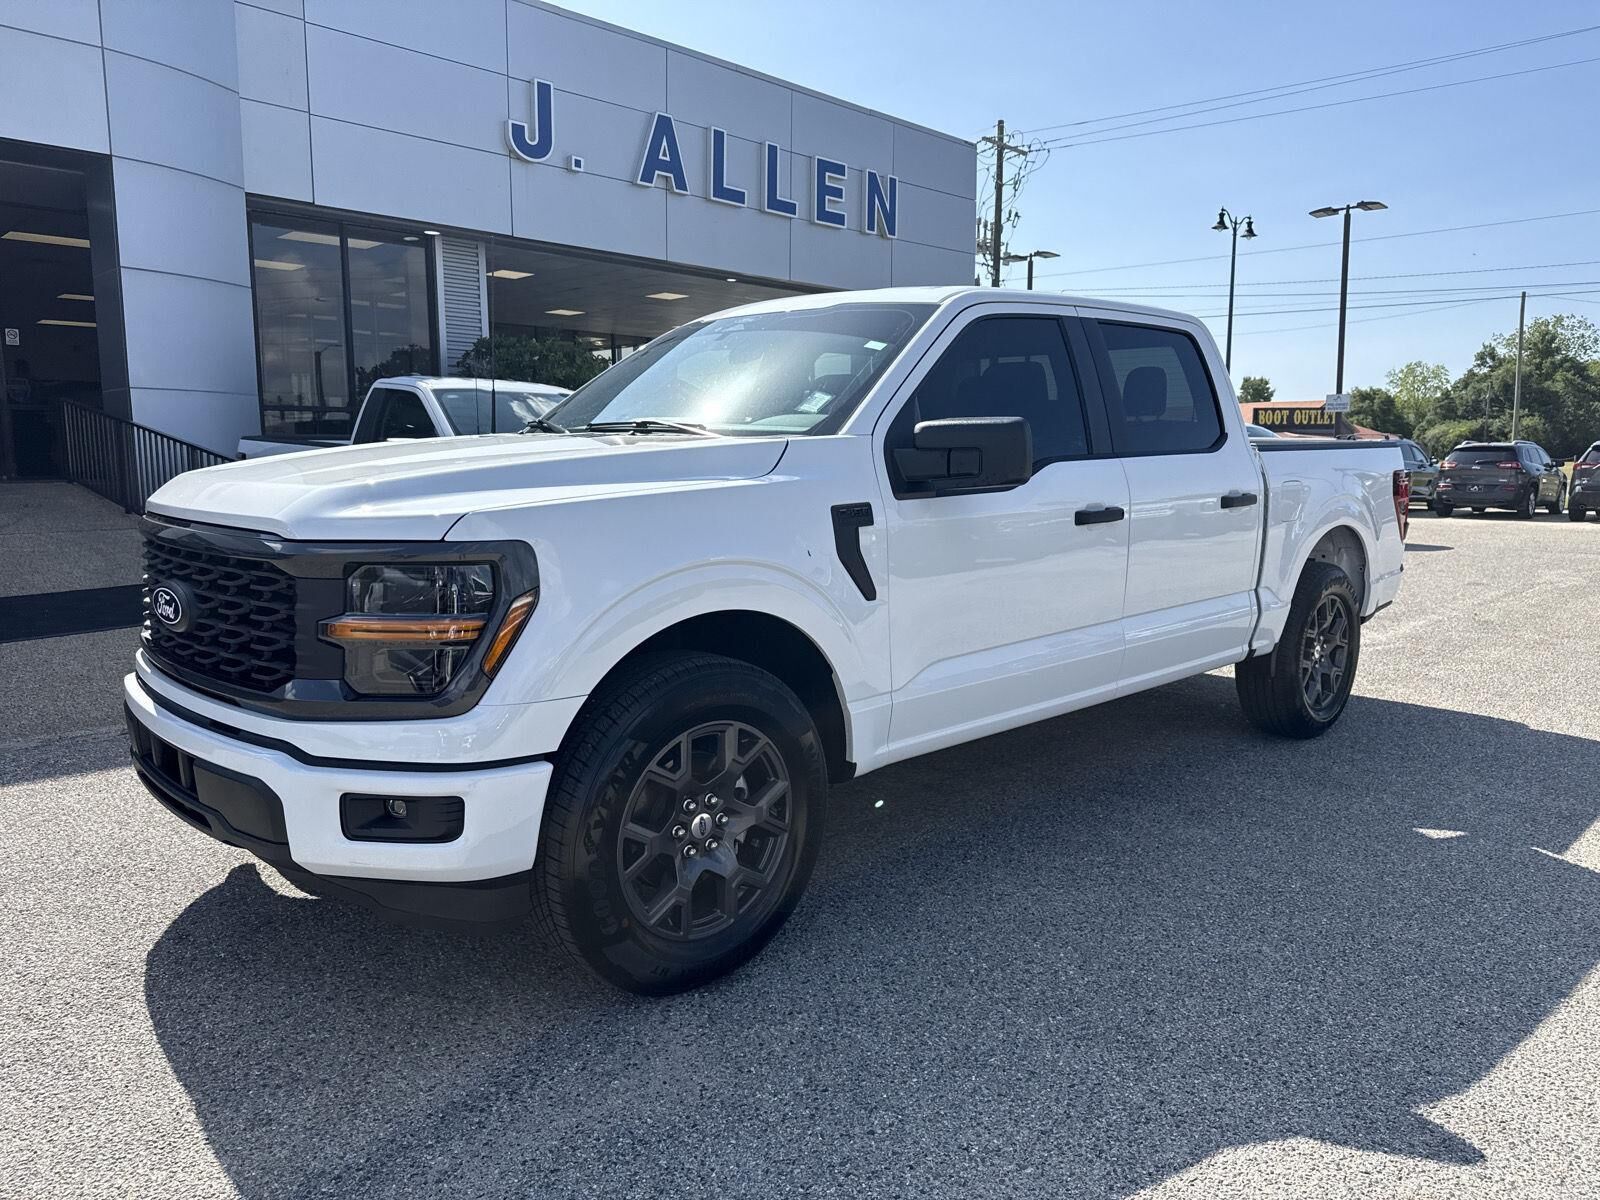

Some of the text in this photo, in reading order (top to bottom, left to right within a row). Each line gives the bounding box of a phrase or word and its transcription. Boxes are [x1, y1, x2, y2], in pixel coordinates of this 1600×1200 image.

[506, 78, 899, 239] J. ALLEN
[1258, 409, 1289, 425] BOOT
[157, 591, 176, 619] Ford
